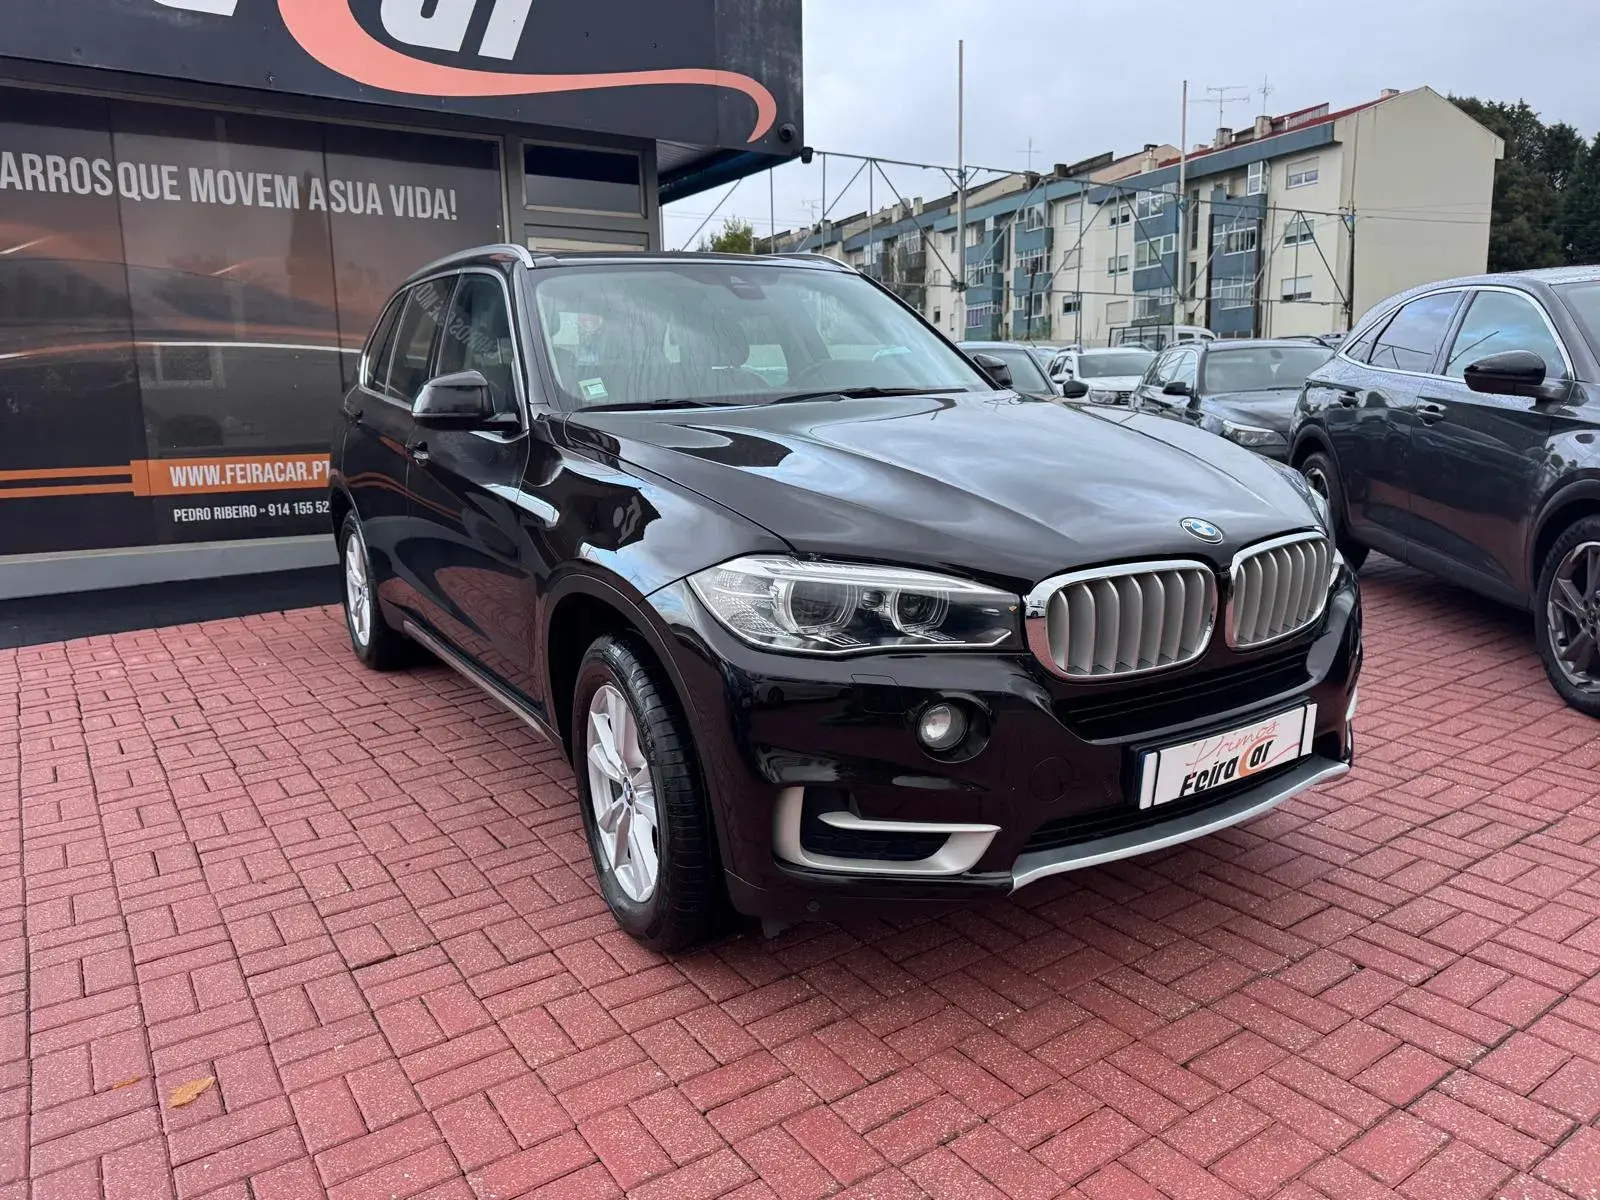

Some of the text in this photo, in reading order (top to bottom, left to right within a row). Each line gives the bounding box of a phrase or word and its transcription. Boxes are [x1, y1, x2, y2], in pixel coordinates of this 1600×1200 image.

[117, 161, 181, 202] QUE
[188, 167, 300, 210] MOVEM
[309, 178, 327, 212] A
[328, 179, 384, 216] SUA
[389, 184, 457, 220] VIDA!
[174, 507, 211, 522] PEDRO
[214, 504, 257, 520] RIBEIRO
[268, 502, 290, 517] 914
[293, 501, 313, 515] 155
[1179, 734, 1279, 797] FeiraCar
